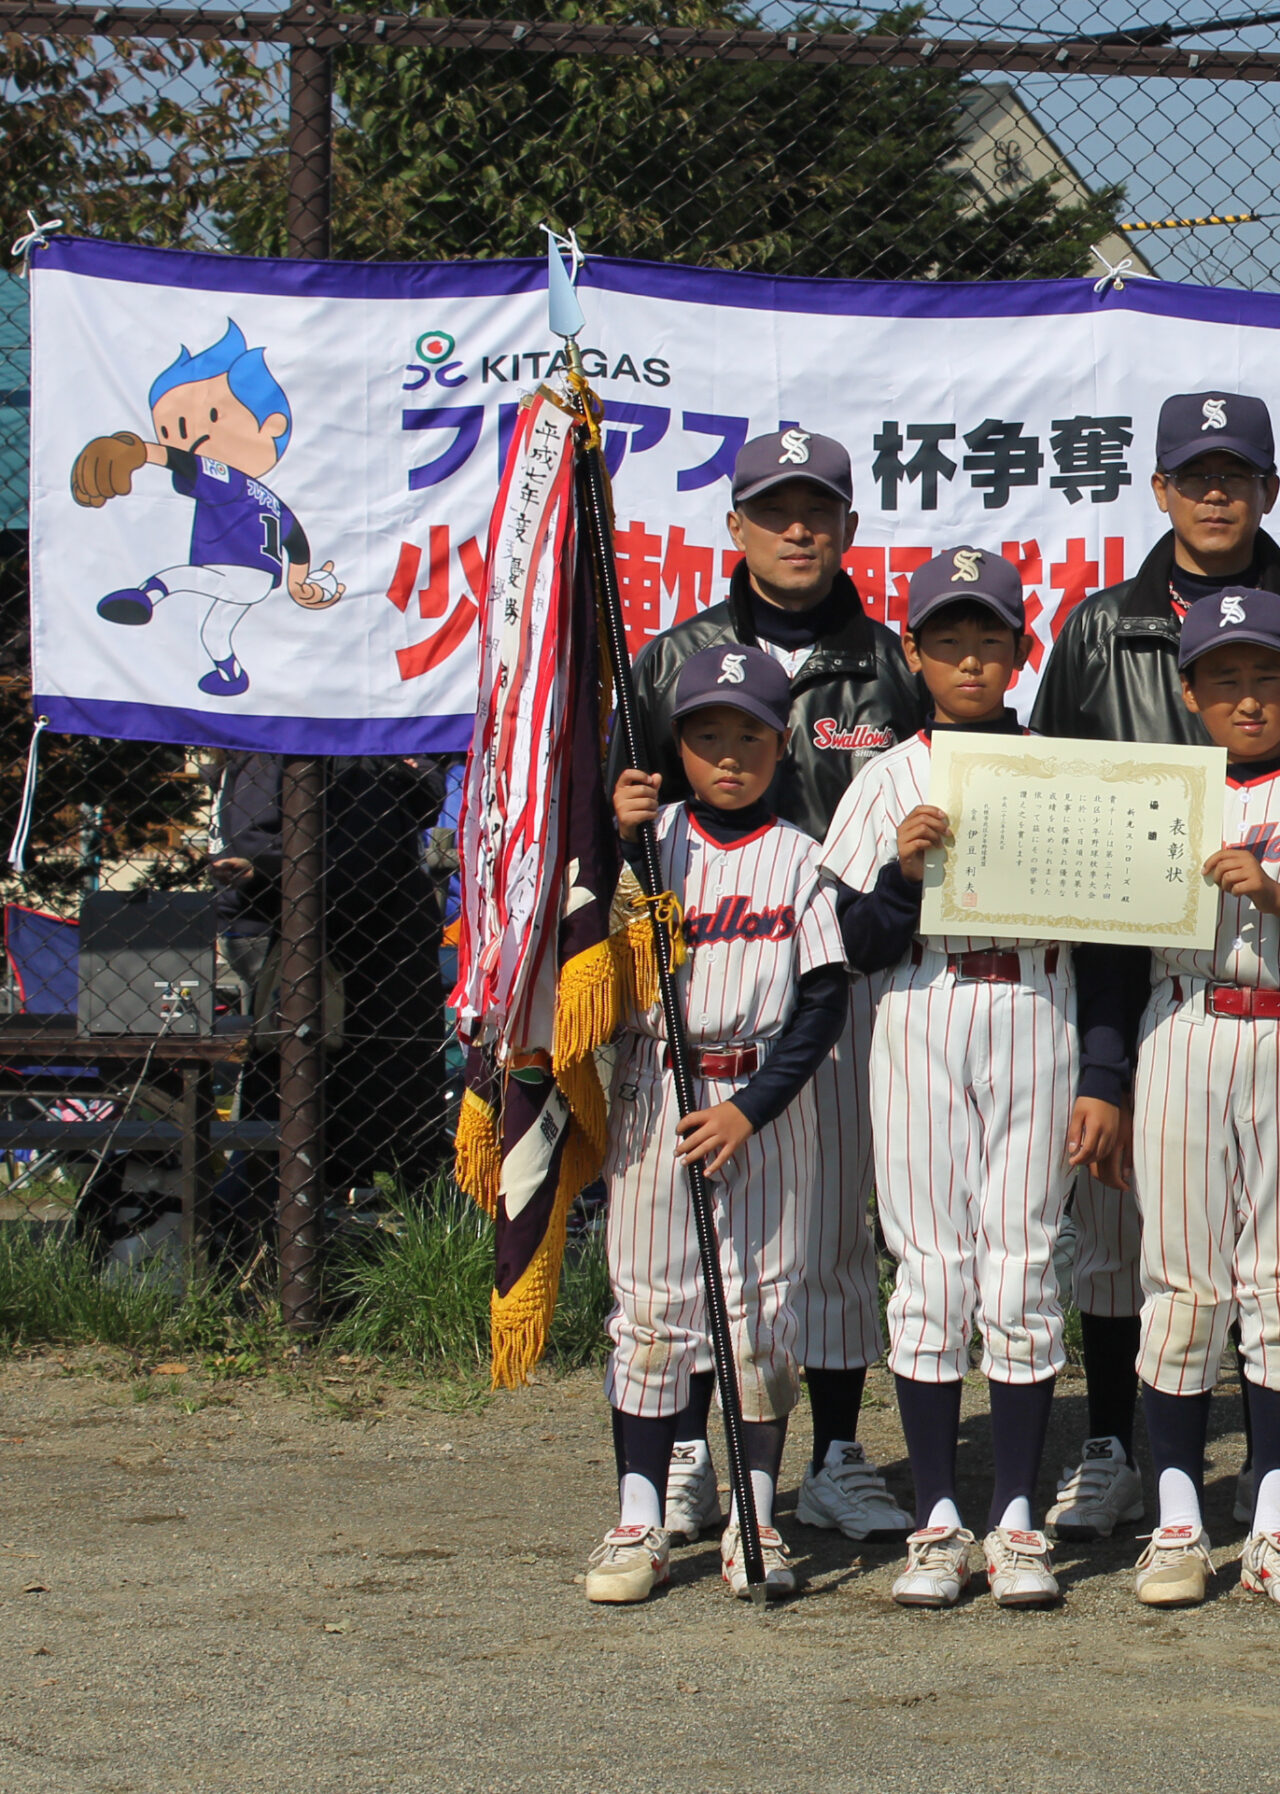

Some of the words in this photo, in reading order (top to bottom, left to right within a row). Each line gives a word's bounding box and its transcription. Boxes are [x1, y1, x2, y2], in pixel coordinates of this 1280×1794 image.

[481, 348, 671, 387] KITAGAS
[1201, 398, 1227, 431] S
[778, 429, 811, 464] S
[259, 512, 284, 566] 1
[950, 549, 982, 582] S
[1219, 596, 1246, 628] S
[717, 653, 746, 684] S
[813, 718, 893, 750] Swallows
[1165, 817, 1187, 884] 表彰状
